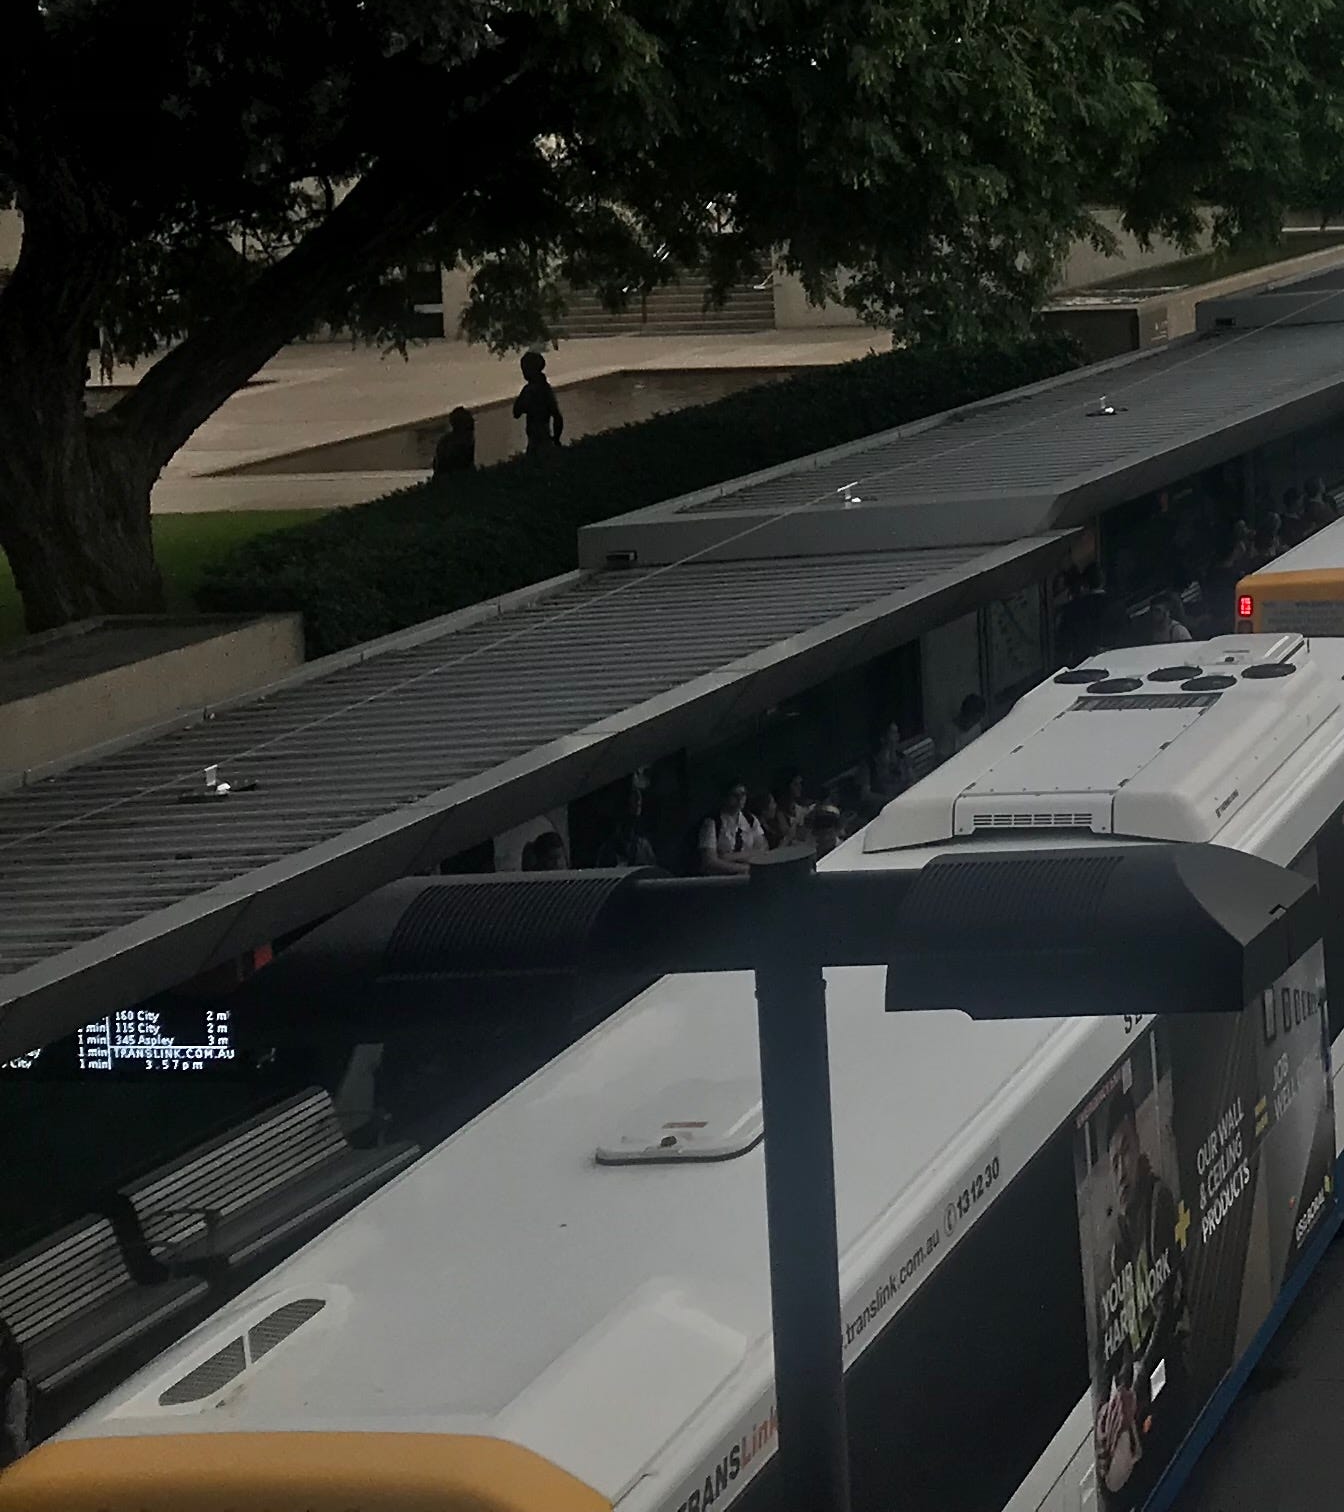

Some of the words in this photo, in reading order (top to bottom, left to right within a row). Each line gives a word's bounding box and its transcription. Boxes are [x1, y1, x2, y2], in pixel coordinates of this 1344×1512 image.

[115, 1022, 135, 1033] 115
[137, 1022, 160, 1035] City
[115, 1034, 135, 1045] 345
[138, 1034, 175, 1047] Aspley
[207, 1035, 215, 1045] 3
[137, 1010, 160, 1023] City
[113, 1048, 235, 1059] TRANSLINK.COM.AU
[1197, 1136, 1218, 1175] OUR
[1217, 1096, 1245, 1140] WALL
[1206, 1131, 1243, 1196] CEILING
[1202, 1158, 1251, 1243] PRODUCTS
[1102, 1261, 1134, 1320] YOUR
[1136, 1248, 1172, 1314] WORK
